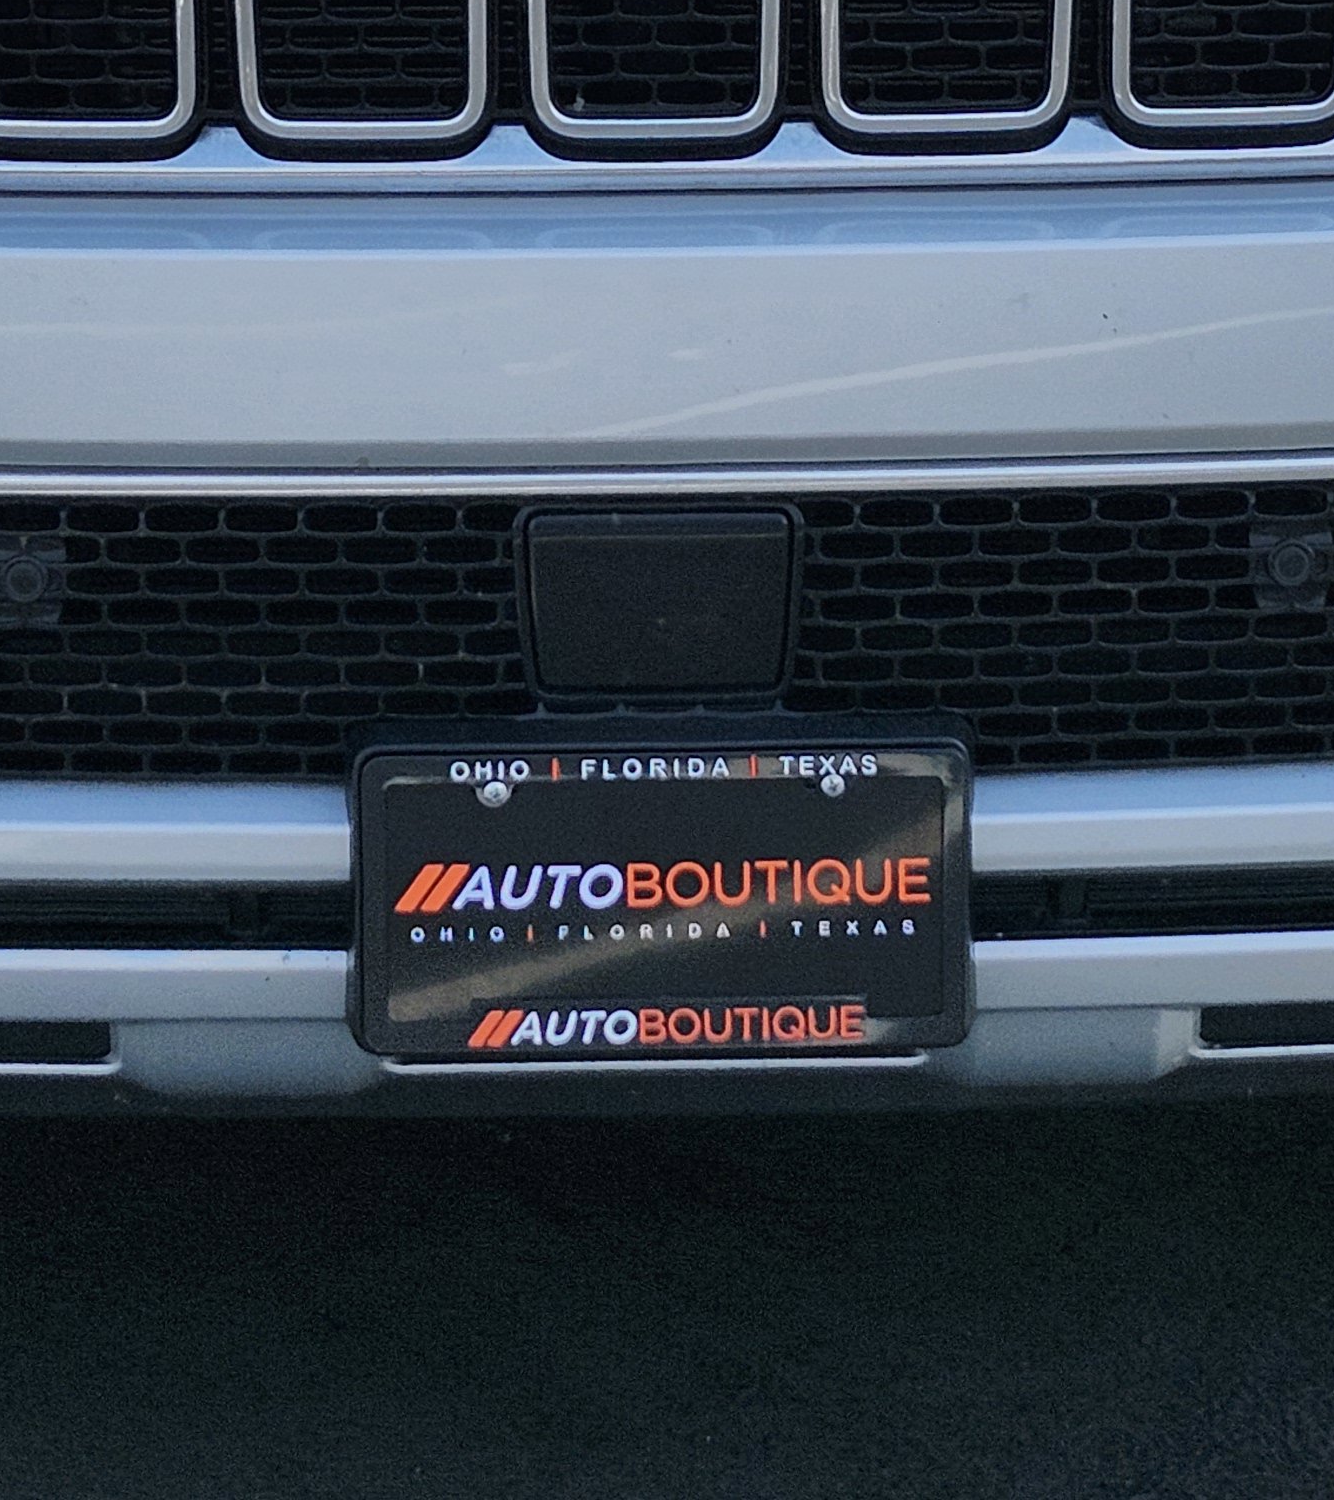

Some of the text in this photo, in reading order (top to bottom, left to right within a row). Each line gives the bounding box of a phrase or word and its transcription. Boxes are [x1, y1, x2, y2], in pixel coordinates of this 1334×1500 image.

[450, 754, 878, 782] OHIO FLORIDA TEXAS
[452, 857, 932, 910] AUTOBOUTIQUE
[410, 918, 916, 943] OHIO FLORIDA TEXAS
[510, 1004, 865, 1047] AUTOBOUTIQUE
